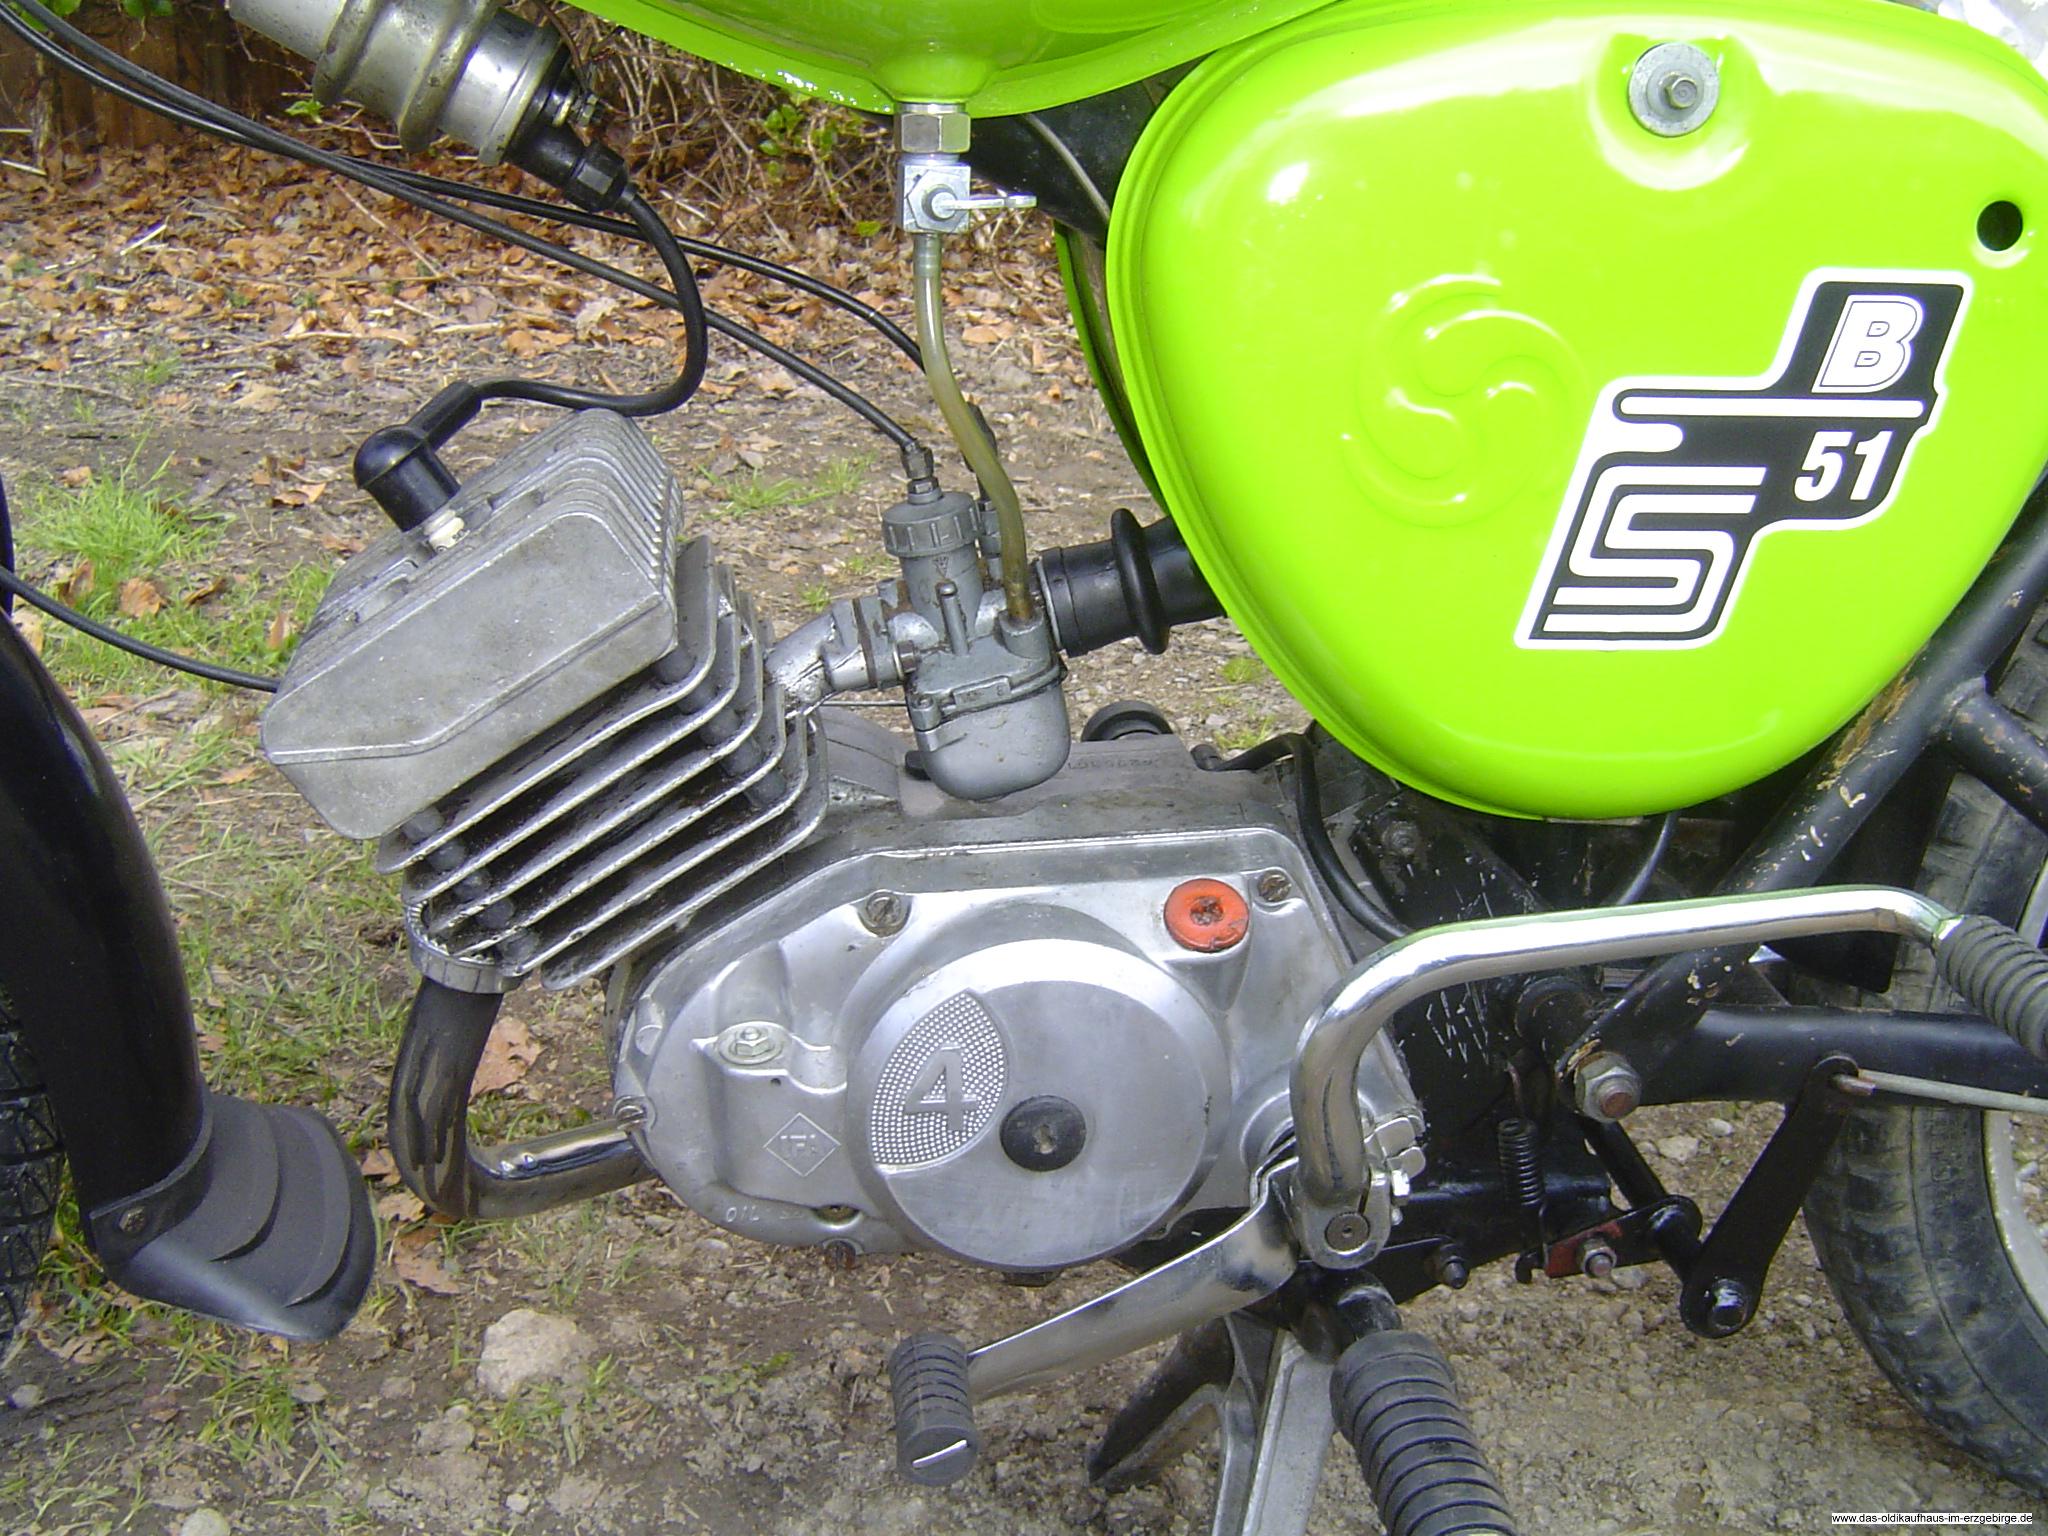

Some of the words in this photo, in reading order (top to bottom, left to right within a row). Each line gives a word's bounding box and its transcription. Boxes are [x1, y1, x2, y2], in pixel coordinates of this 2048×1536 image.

[1811, 295, 1924, 393] B
[1794, 430, 1893, 502] 51
[903, 1044, 979, 1132] 4
